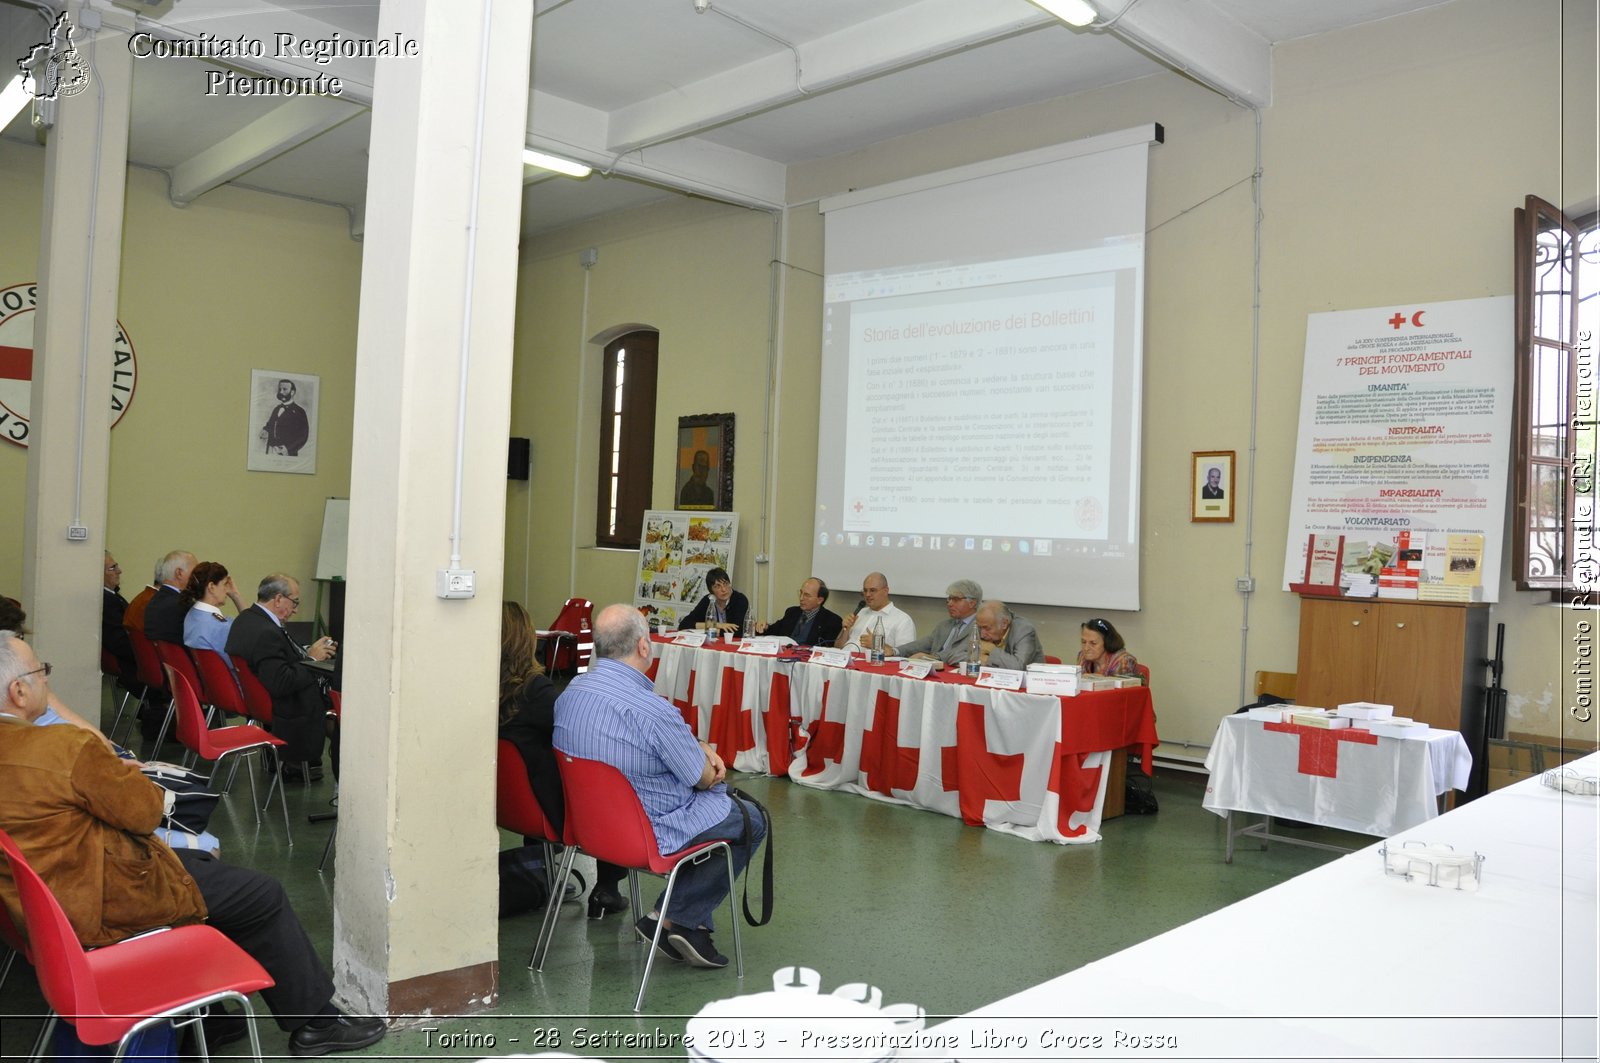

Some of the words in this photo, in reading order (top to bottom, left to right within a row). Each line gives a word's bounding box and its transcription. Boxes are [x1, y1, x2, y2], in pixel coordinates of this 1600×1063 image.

[864, 326, 900, 343] Storia
[903, 318, 1001, 339] dell'evoluzione
[1005, 314, 1026, 330] dei
[1031, 306, 1095, 328] Bollettini
[1336, 358, 1342, 367] 7
[1345, 356, 1386, 366] PRINCIPI
[1389, 350, 1472, 364] FONDAMENTALI
[1359, 367, 1379, 376] DEL
[1381, 363, 1445, 375] MOVIMENTO
[1353, 455, 1412, 464] INDIPENDENZA
[1344, 517, 1410, 526] VOLONTARIATO
